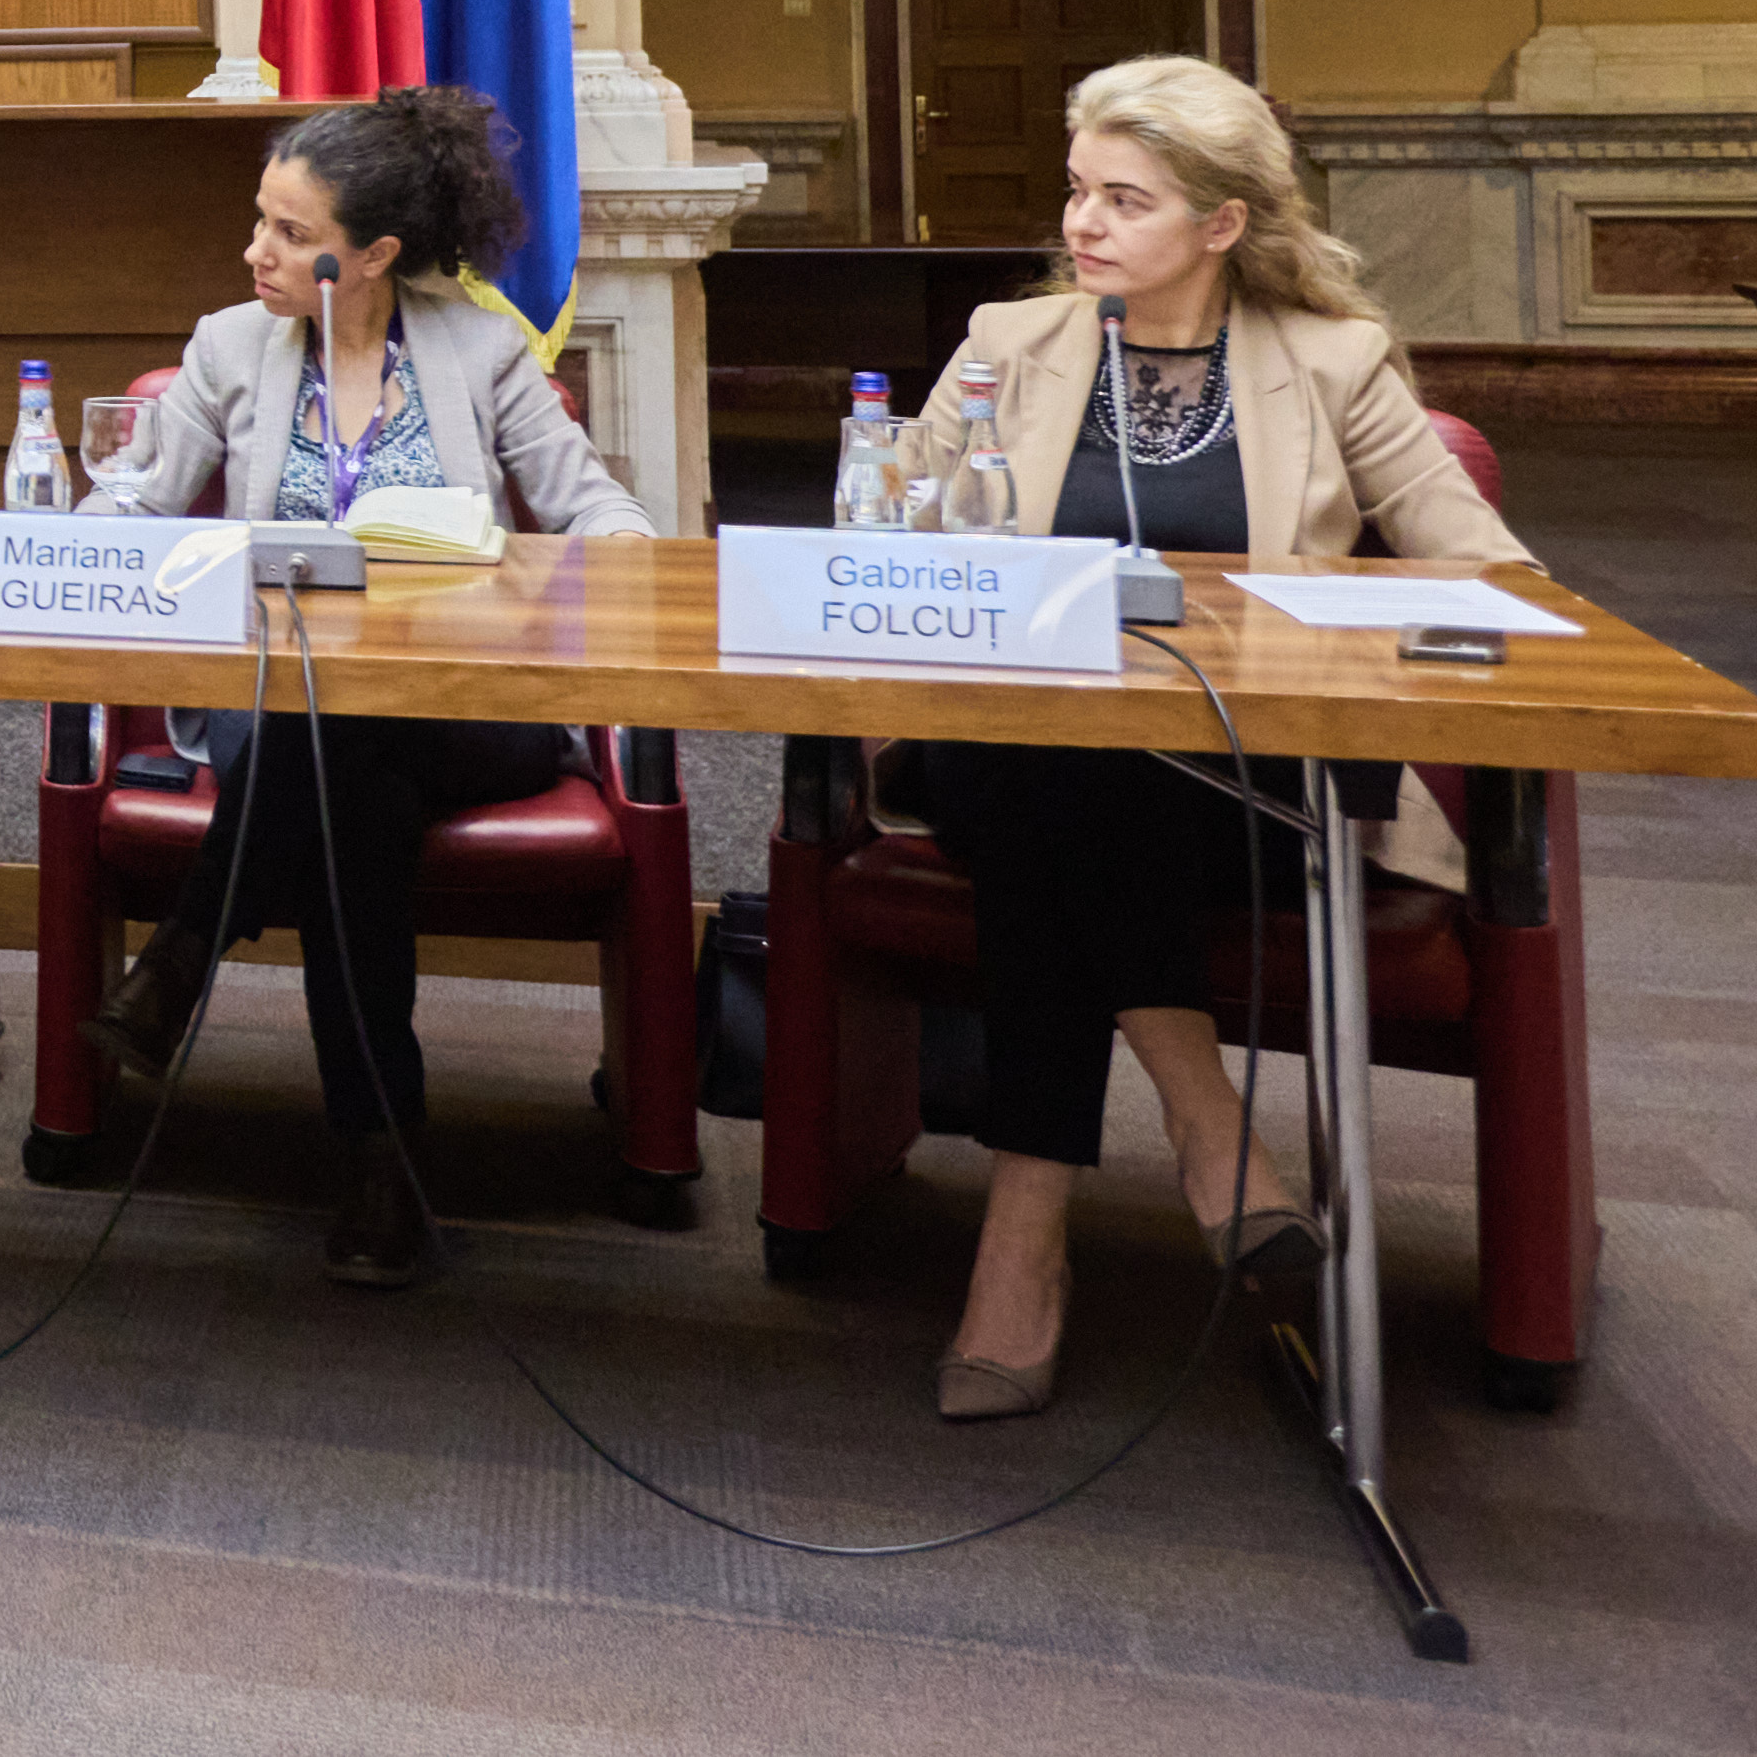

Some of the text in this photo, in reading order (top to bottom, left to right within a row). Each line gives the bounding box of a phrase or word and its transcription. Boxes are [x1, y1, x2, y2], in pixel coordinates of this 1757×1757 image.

[3, 536, 144, 570] Mariana
[827, 555, 999, 592] Gabriela
[822, 601, 1006, 651] FOLCUȚ
